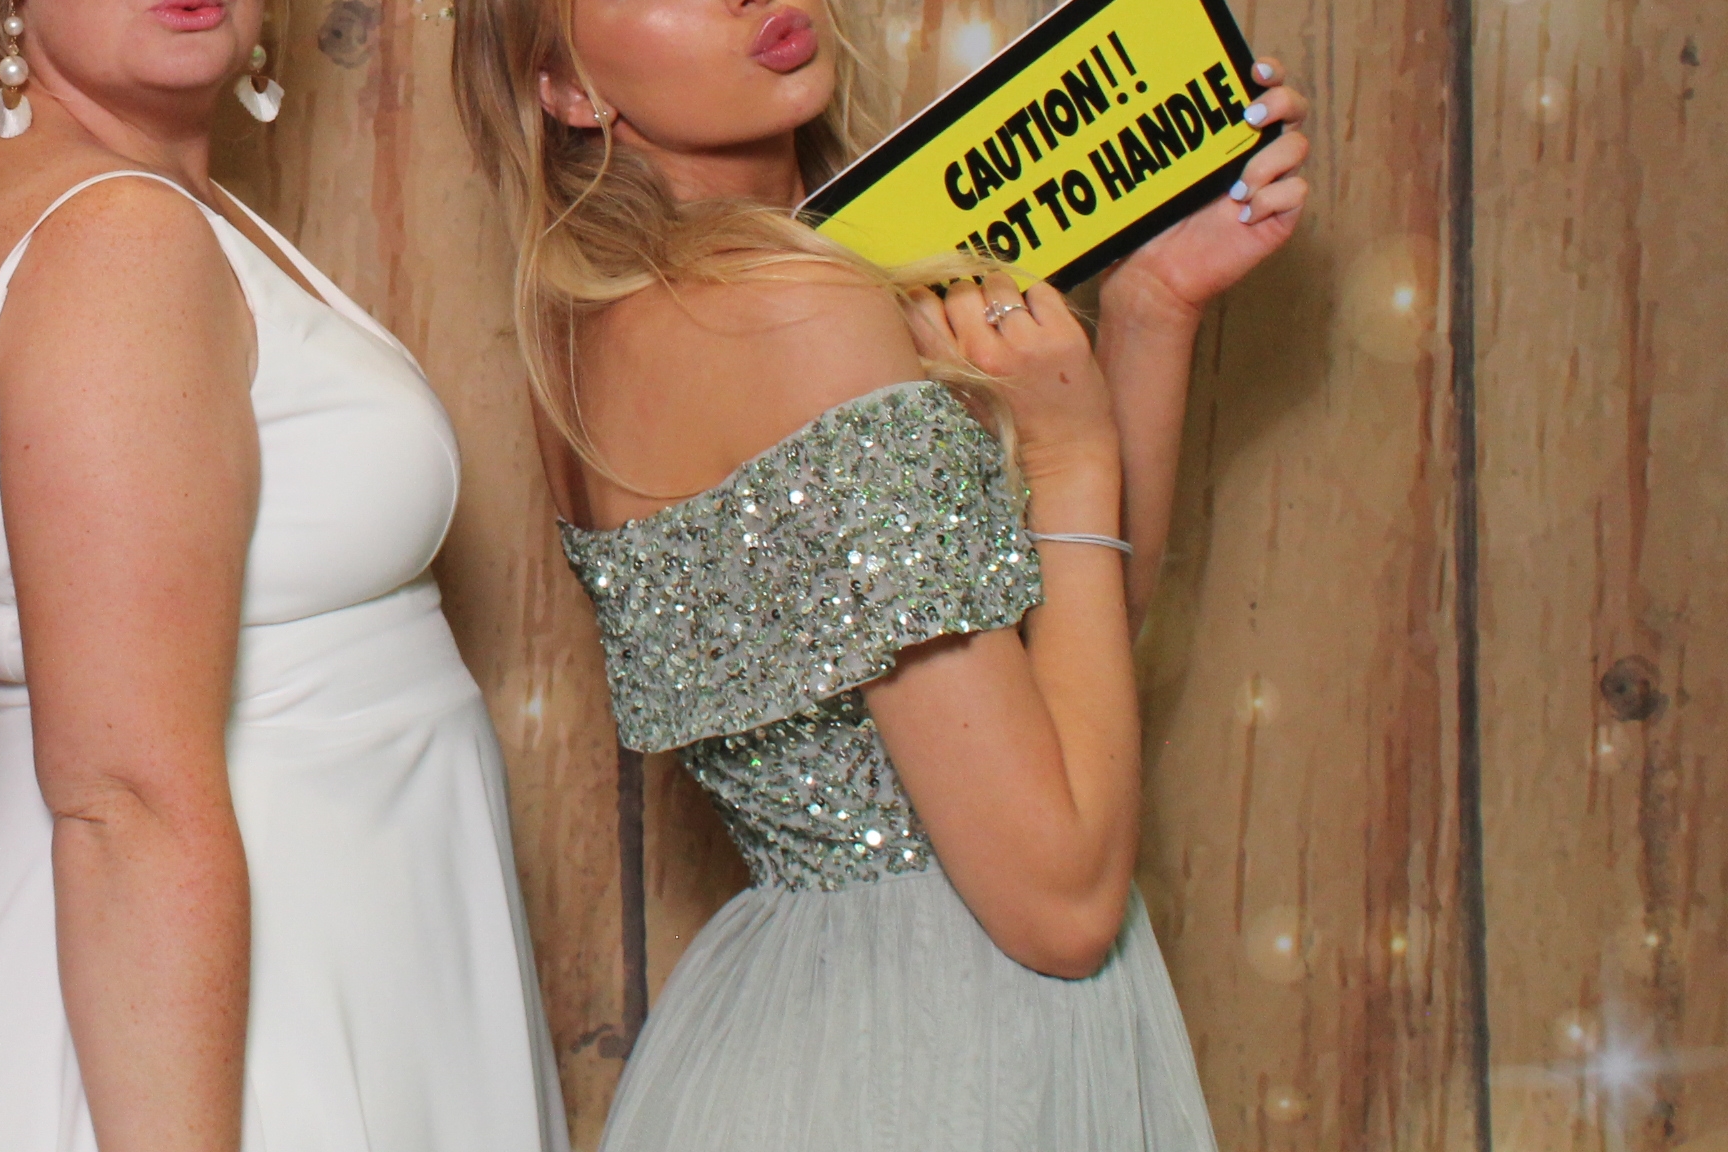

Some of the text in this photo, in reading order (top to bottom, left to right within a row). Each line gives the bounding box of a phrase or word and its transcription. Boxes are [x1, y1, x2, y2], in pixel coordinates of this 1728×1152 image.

[944, 31, 1148, 210] CAUTION!!
[1032, 168, 1097, 232] TO
[1088, 61, 1245, 201] HANDLE
